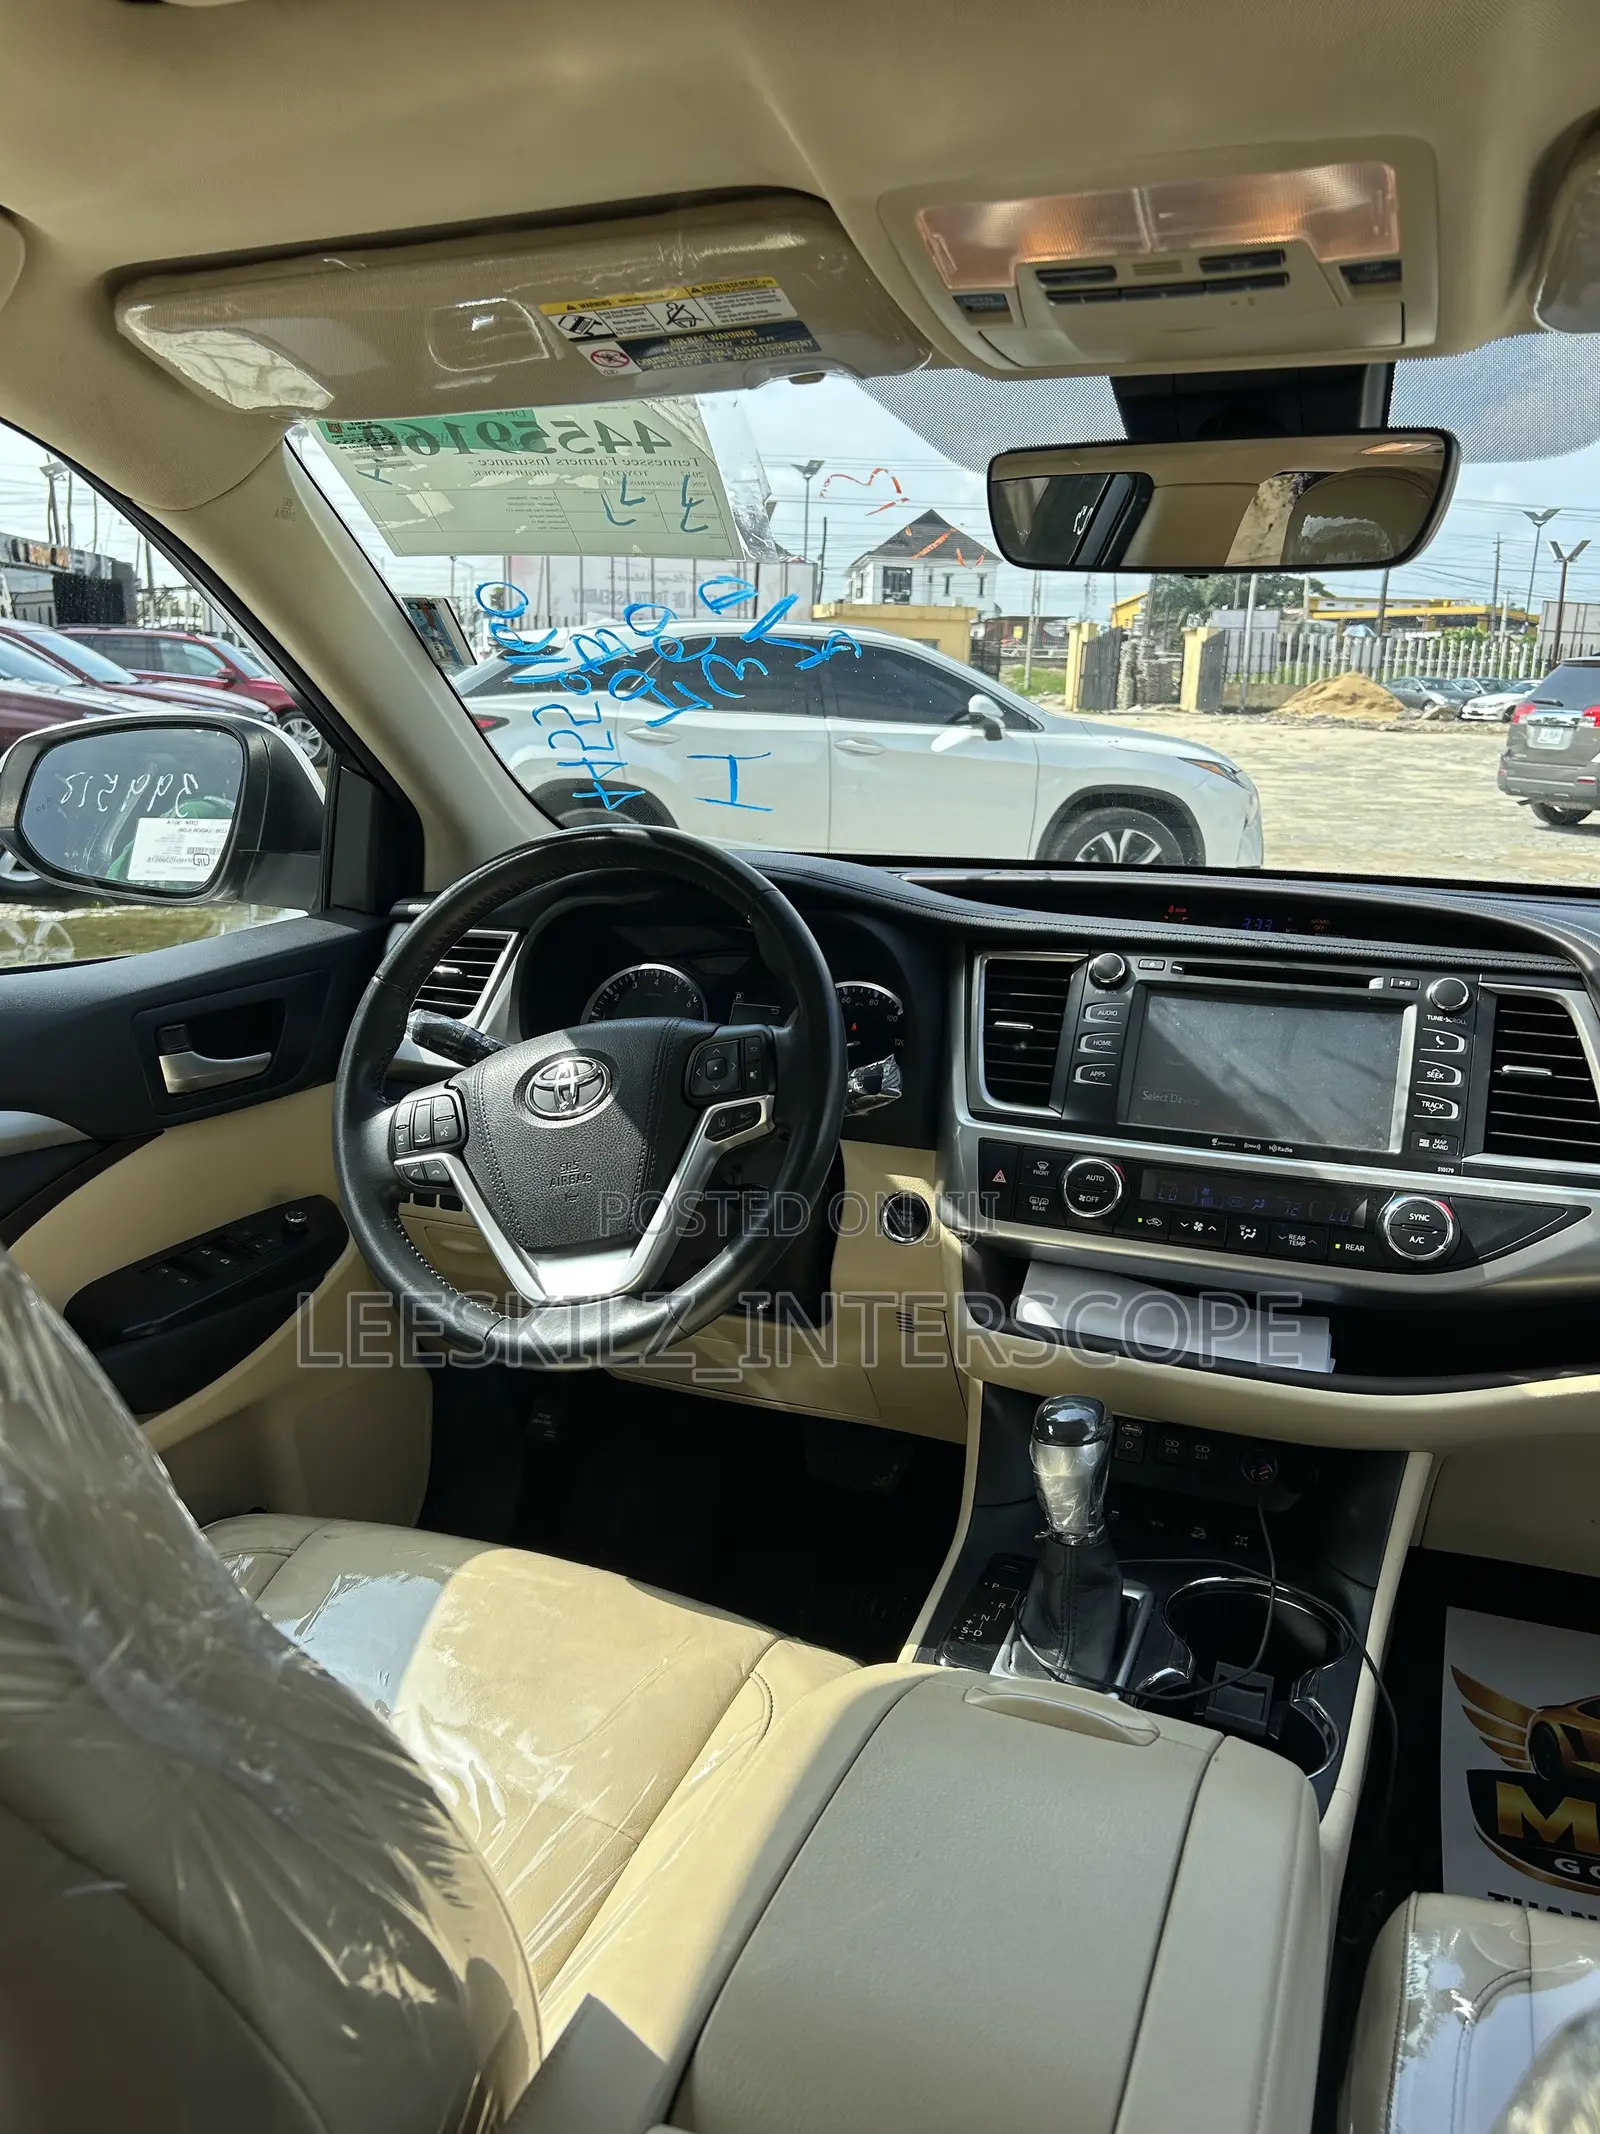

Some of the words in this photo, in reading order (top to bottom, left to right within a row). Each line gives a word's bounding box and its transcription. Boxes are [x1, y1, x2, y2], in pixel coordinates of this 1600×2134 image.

[708, 328, 757, 342] WARNING
[740, 335, 776, 345] OVER
[734, 339, 813, 355] AVERTISSEMENT
[868, 999, 880, 1007] 80
[1097, 1009, 1118, 1017] AUDIO
[886, 1014, 899, 1023] 100
[1092, 1039, 1112, 1047] HOME
[1089, 1070, 1106, 1078] APPS
[1426, 1071, 1445, 1080] SEEK
[1142, 1090, 1169, 1102] Select
[1421, 1100, 1445, 1110] TRACK
[1432, 1143, 1449, 1151] CARD
[1032, 1168, 1050, 1177] FRONT
[1085, 1174, 1105, 1183] AUTO
[1085, 1195, 1100, 1203] OFF
[1031, 1204, 1046, 1212] REAR
[1409, 1213, 1431, 1222] SYNC
[1288, 1233, 1306, 1241] REAR
[1409, 1236, 1425, 1244] A/C
[1288, 1239, 1306, 1247] TEMP
[1345, 1243, 1365, 1252] REAR
